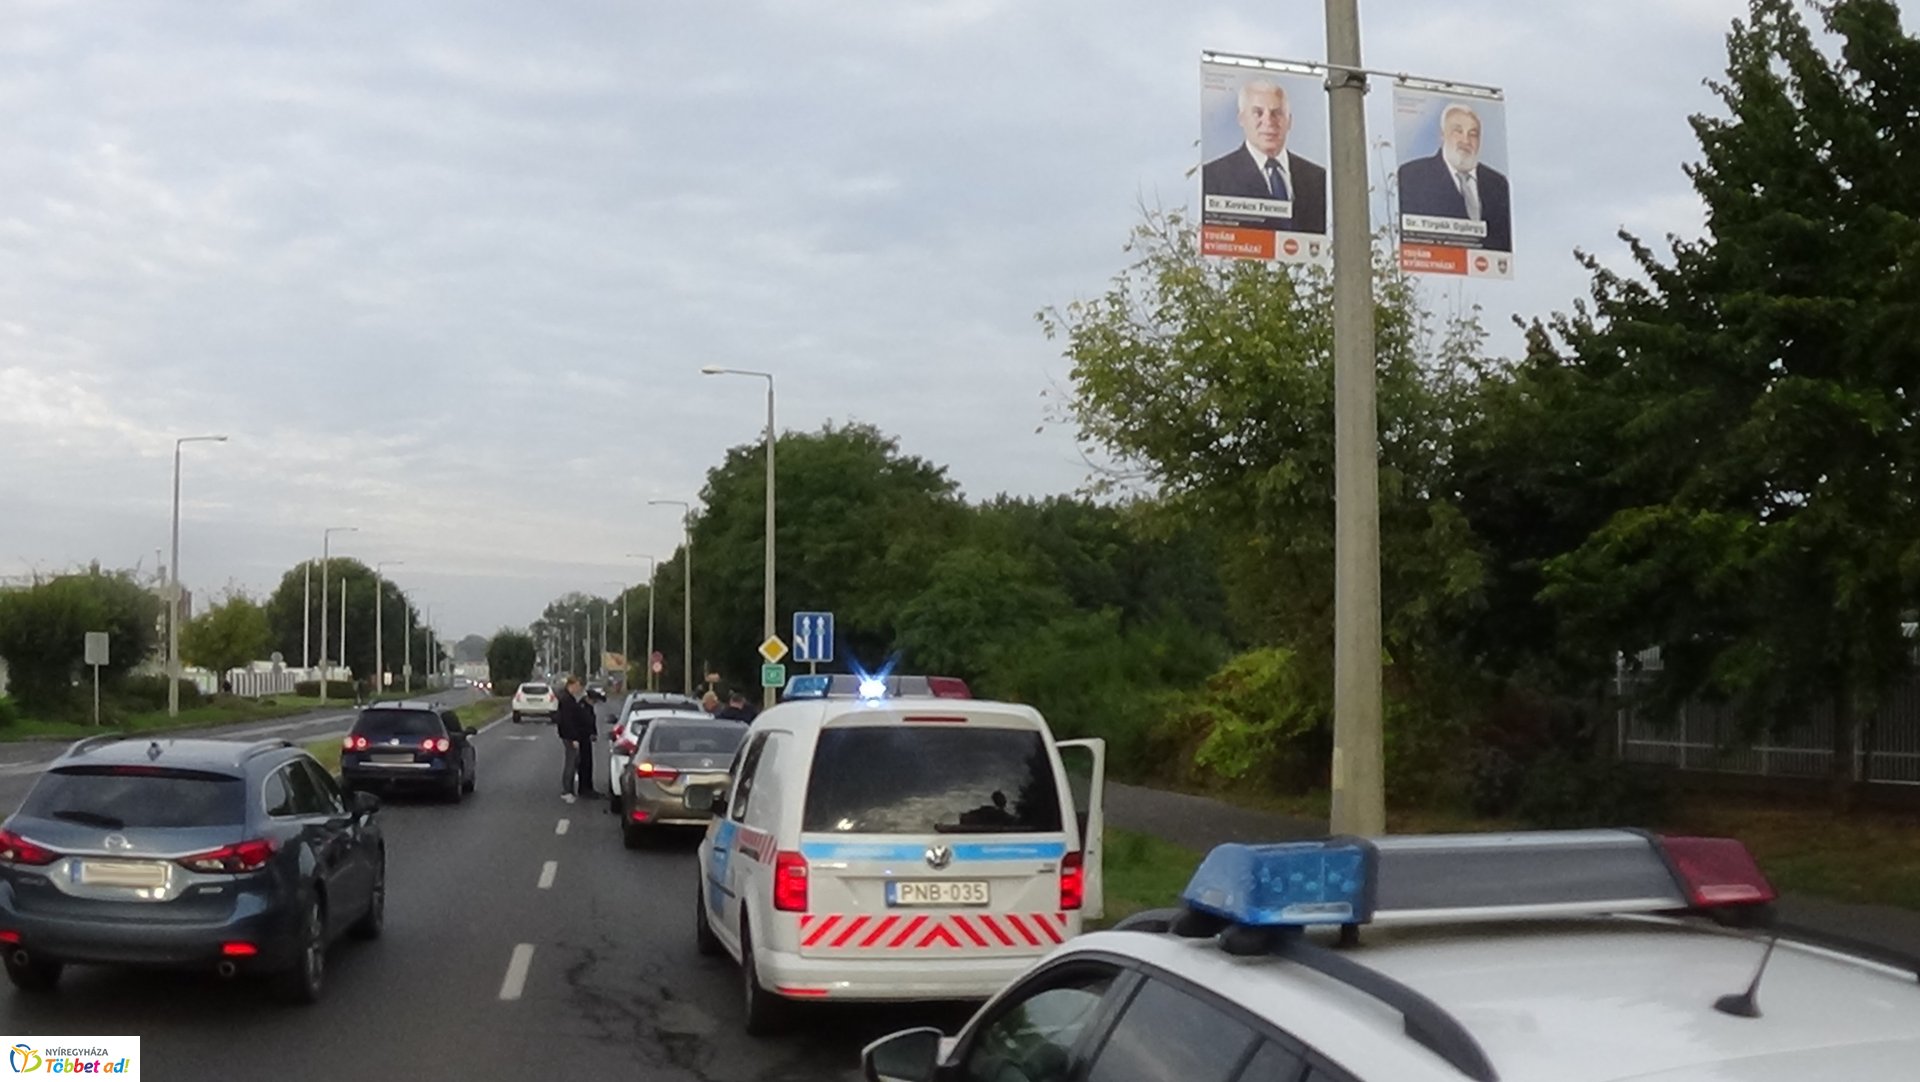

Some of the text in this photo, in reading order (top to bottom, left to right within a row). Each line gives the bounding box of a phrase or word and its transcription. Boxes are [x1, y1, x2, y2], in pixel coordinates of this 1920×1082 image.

[1208, 199, 1289, 213] Dr. Kovács Ferenc
[1405, 218, 1418, 227] Dr.
[900, 883, 985, 902] PNB-035
